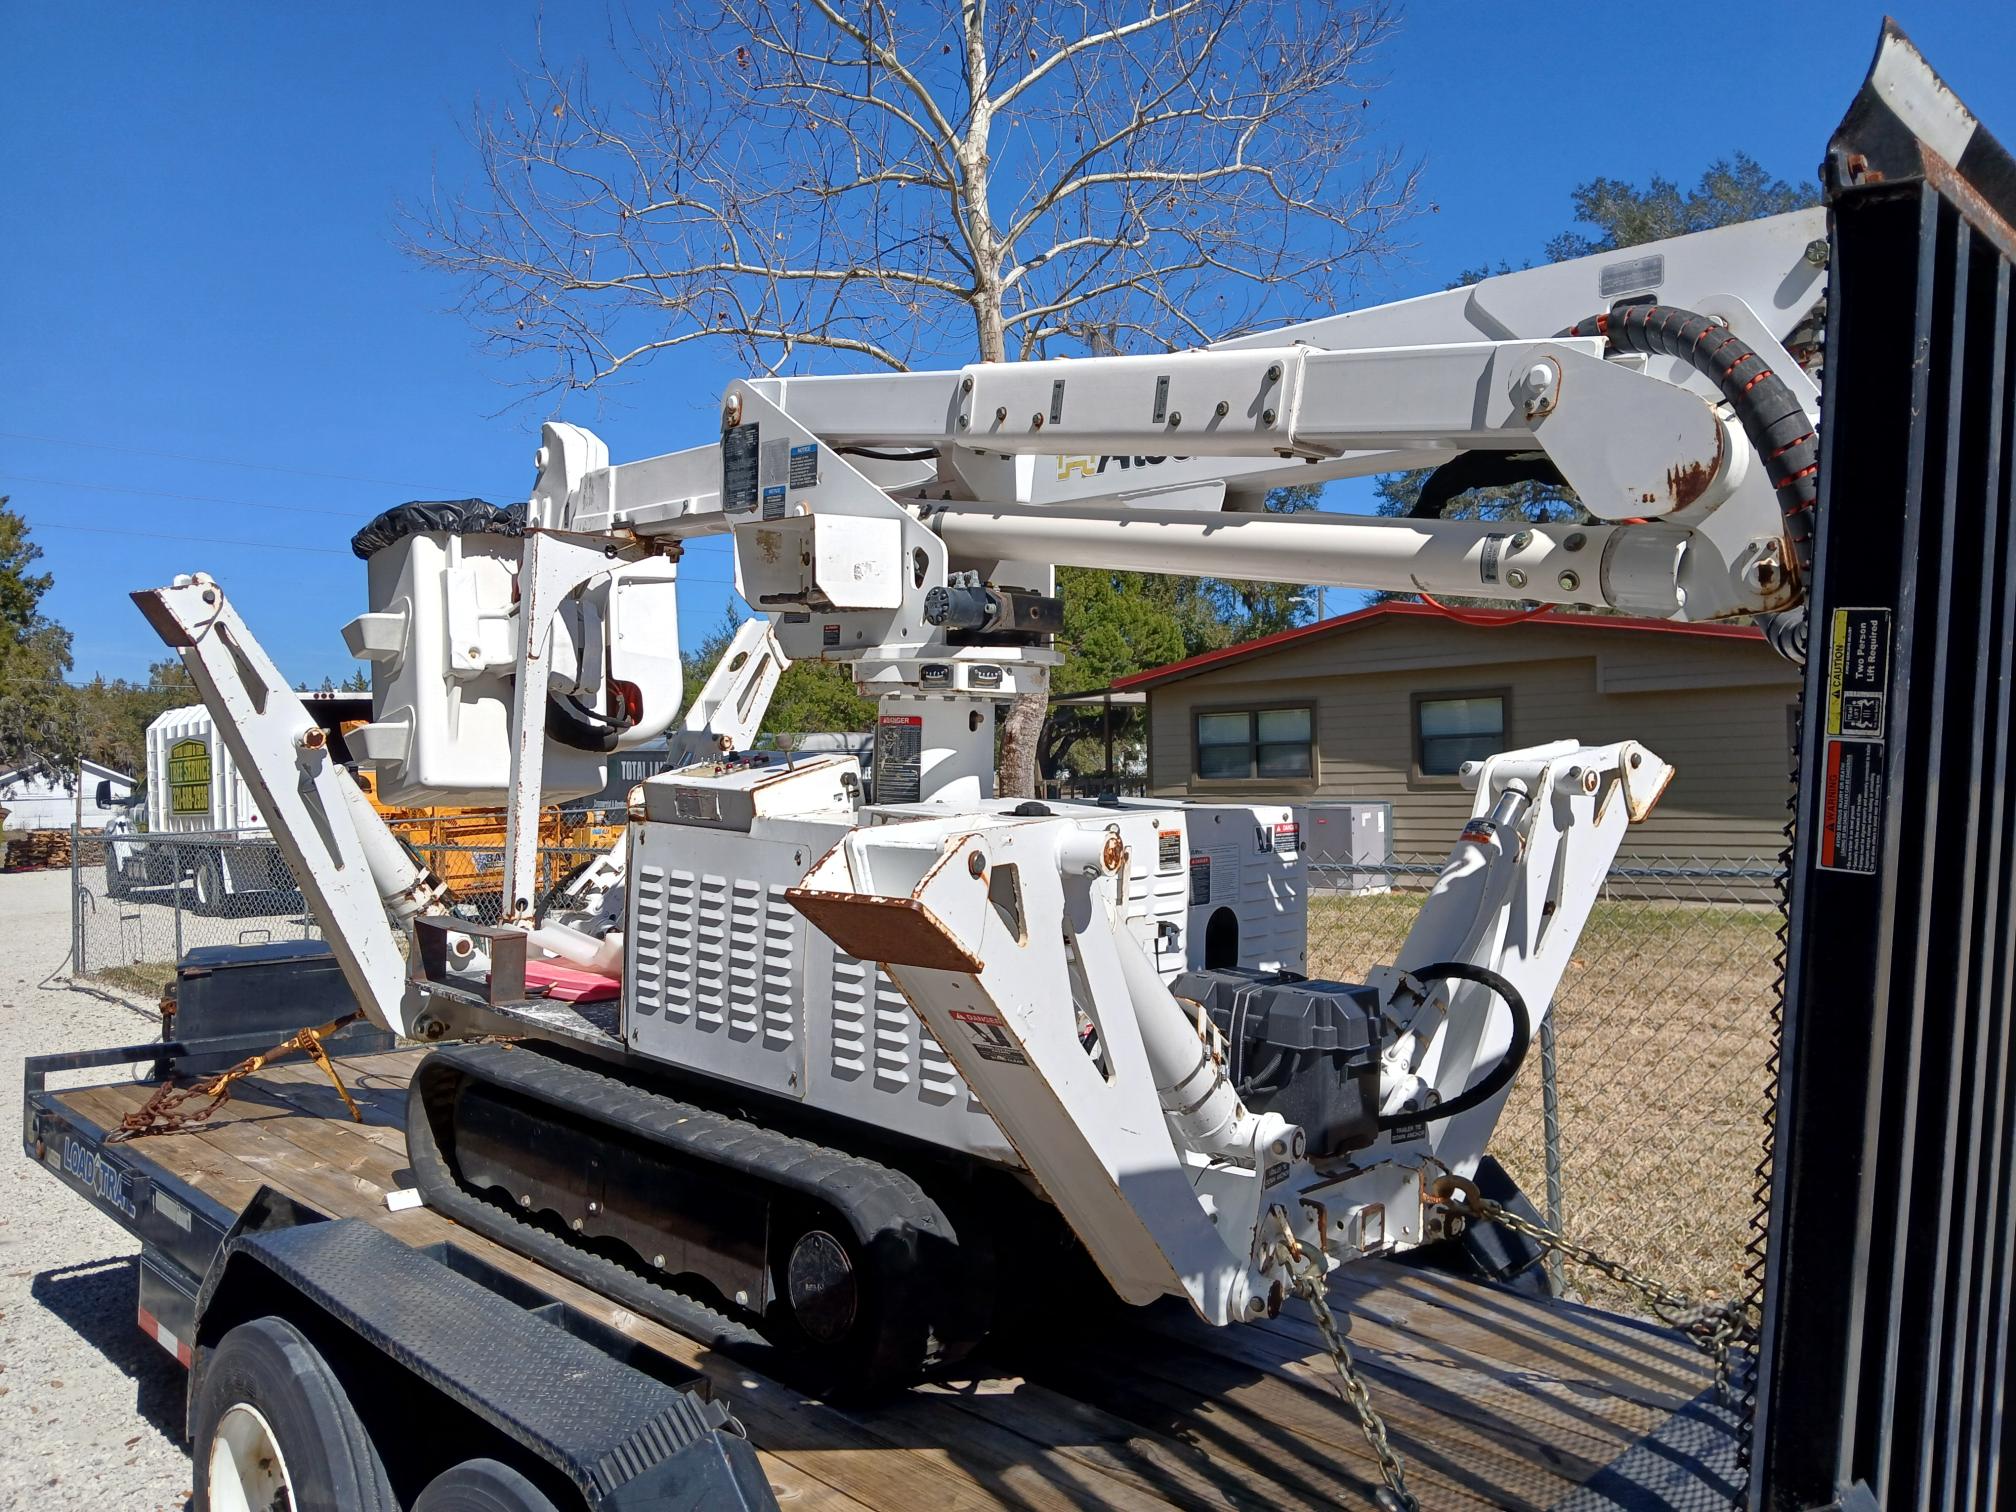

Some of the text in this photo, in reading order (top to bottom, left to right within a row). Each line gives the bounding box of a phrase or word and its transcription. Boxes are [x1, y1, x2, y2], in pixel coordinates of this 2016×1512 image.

[1833, 645, 1843, 687] CAUTION
[1856, 623, 1866, 679] Two Person
[1867, 620, 1878, 682] Lift Required
[170, 759, 211, 783] TREE SERVICE
[621, 760, 646, 780] TOTAL
[1827, 775, 1837, 821] WARNING
[64, 1136, 95, 1185] LOAD
